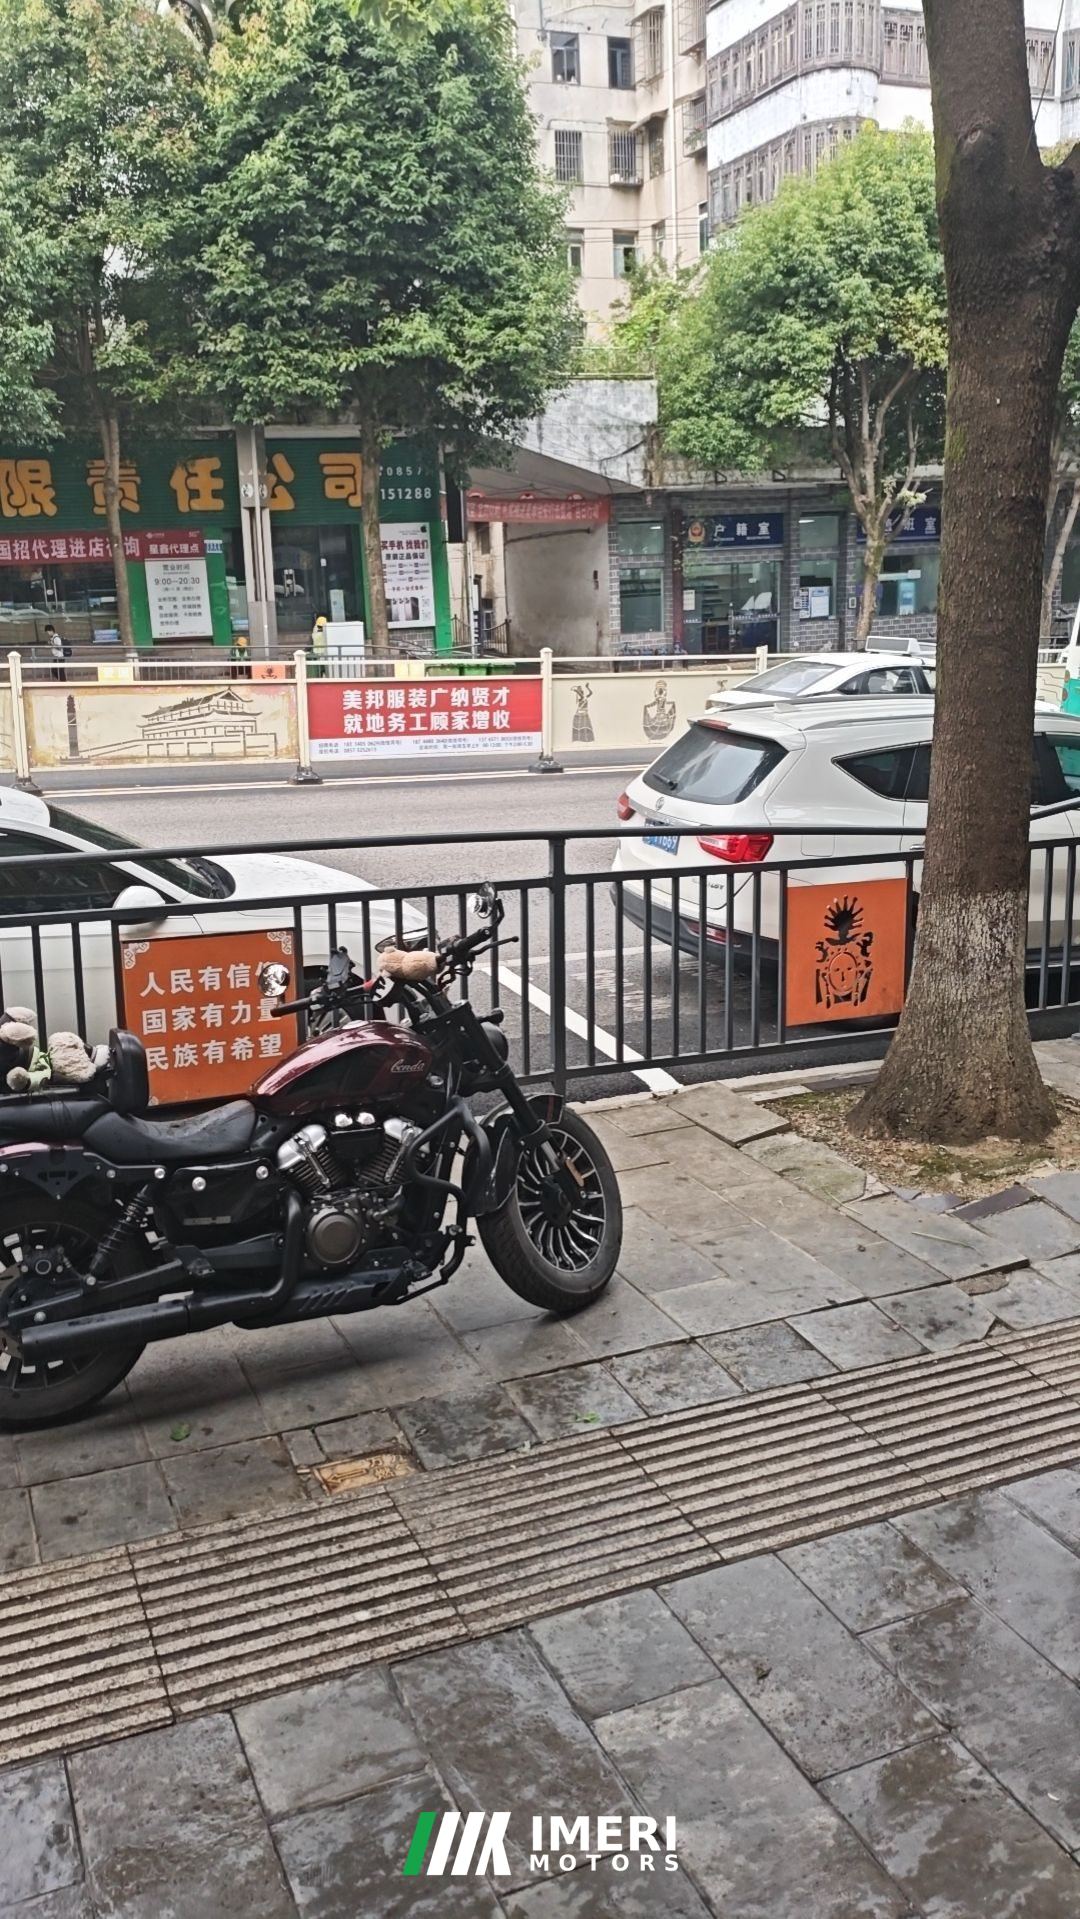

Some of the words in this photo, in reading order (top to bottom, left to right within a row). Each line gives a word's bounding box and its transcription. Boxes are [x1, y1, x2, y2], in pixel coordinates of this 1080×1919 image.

[714, 522, 770, 536] 户籍室
[342, 687, 511, 710] 美邦服装广纳贤才
[343, 710, 511, 735] 就地务工顾家增收
[142, 998, 282, 1036] 国家有力量
[146, 1033, 283, 1072] 民族有希望
